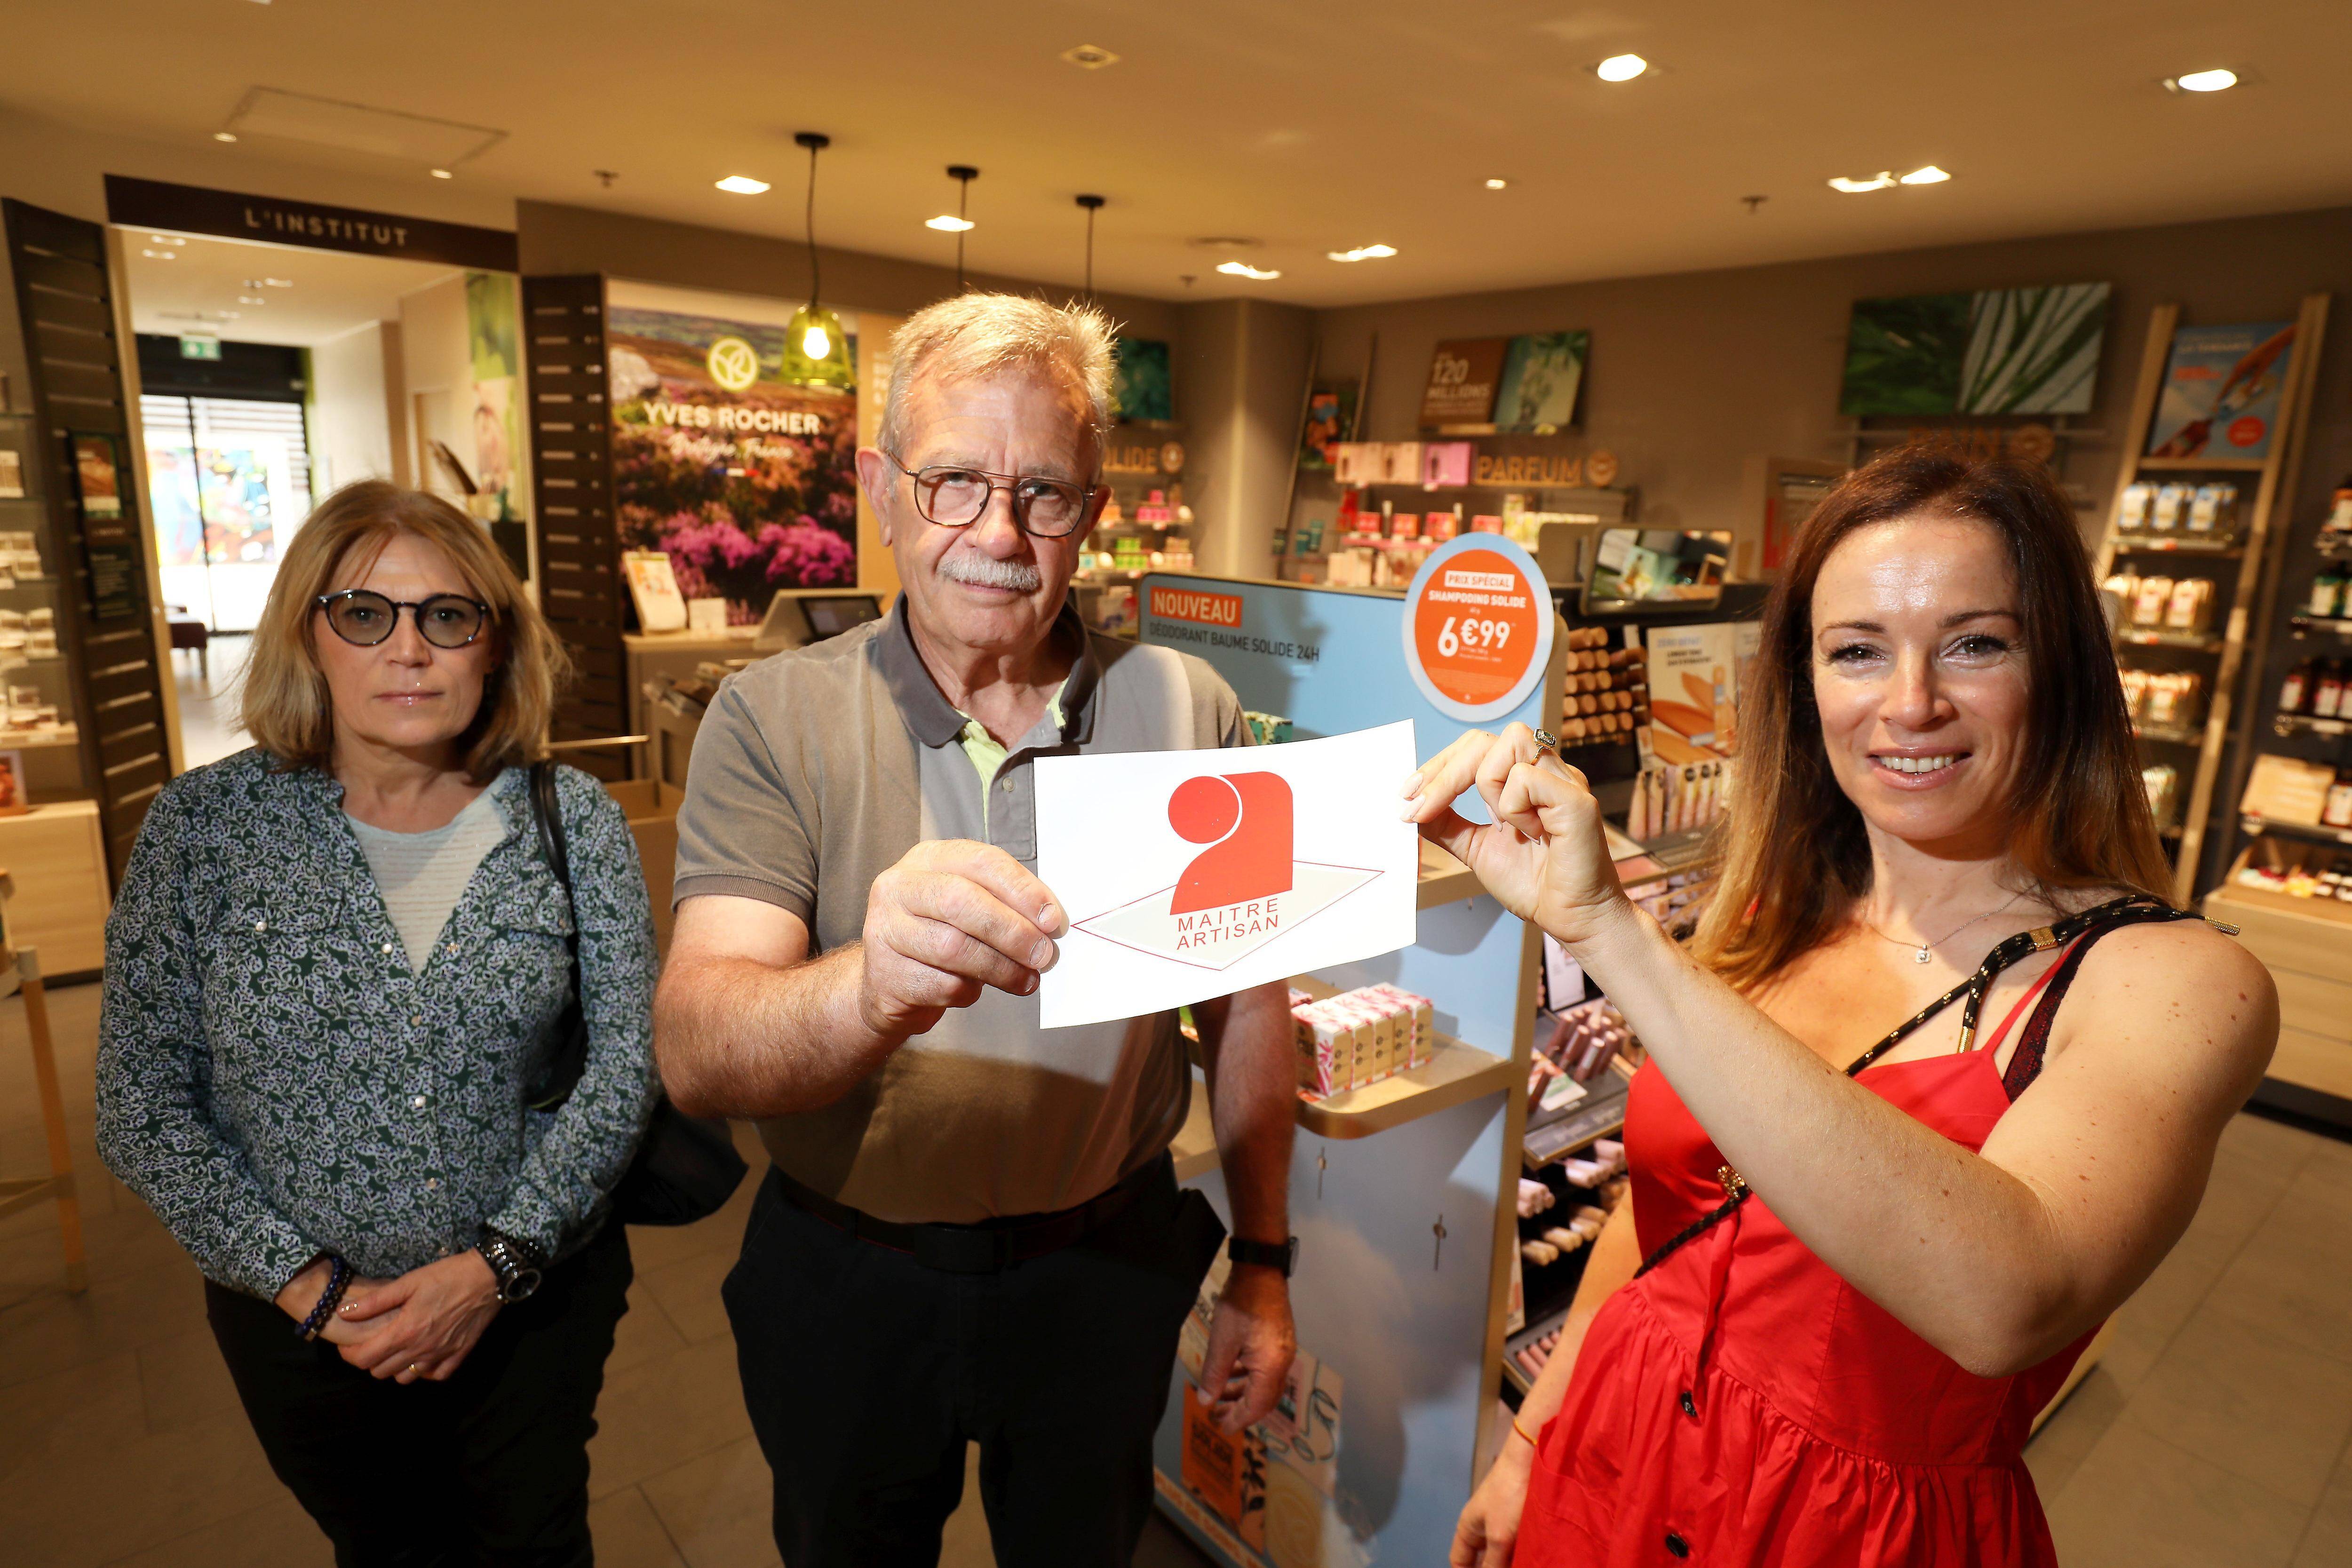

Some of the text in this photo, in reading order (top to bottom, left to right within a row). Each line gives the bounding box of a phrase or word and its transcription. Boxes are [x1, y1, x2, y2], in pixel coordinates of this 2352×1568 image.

[245, 207, 407, 247] L'INSTITUT
[643, 401, 820, 436] YVES ROCHER
[1477, 454, 1582, 484] PARFUM
[1448, 574, 1510, 588] PRIX SPÉCIAL
[1154, 591, 1237, 624] NOUVEAU
[1428, 589, 1526, 608] SHAMPOOING SOLIDE
[1150, 620, 1319, 662] DÉODORANT BAUME SOLIDE 24H
[1178, 898, 1278, 932] MAITRE
[1177, 915, 1278, 950] ARTISAN
